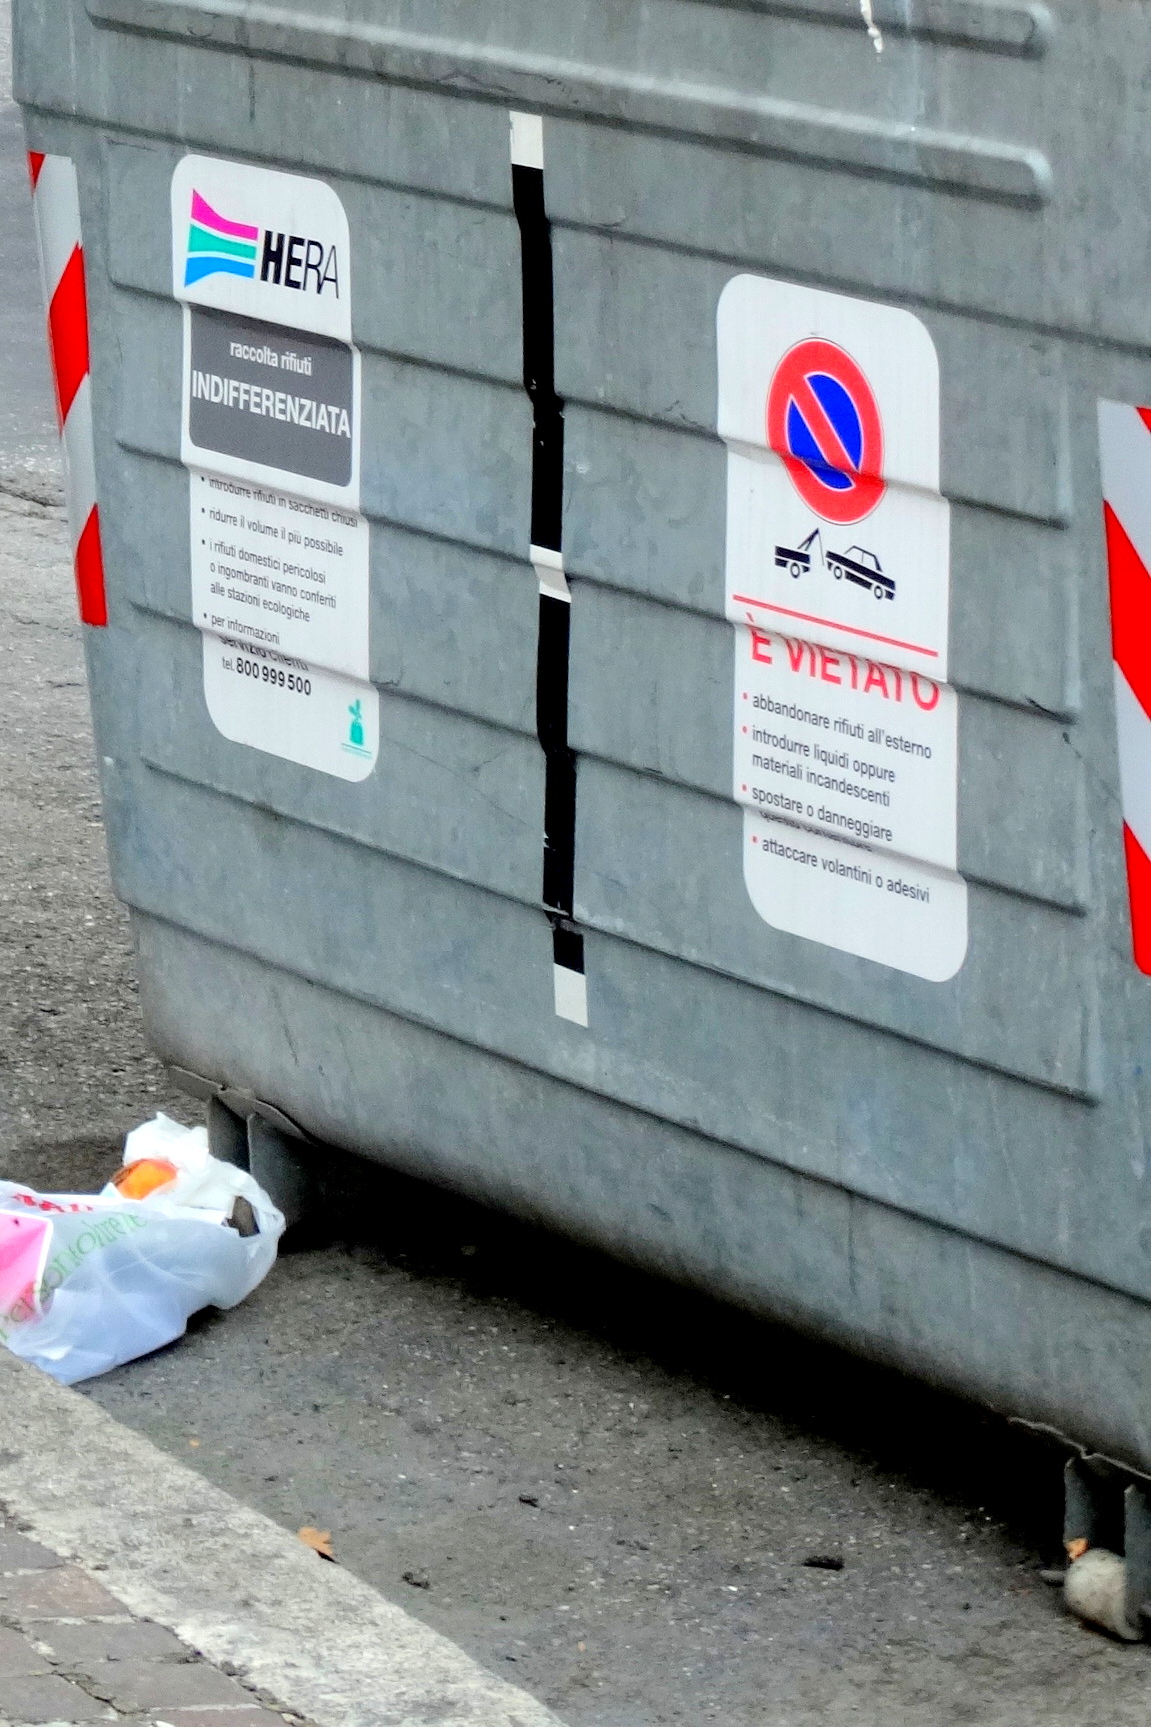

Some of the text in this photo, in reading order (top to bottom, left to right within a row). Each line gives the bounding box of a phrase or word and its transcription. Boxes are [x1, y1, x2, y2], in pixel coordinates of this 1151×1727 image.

[260, 229, 339, 299] HERA
[230, 342, 312, 376] raccolta rifiuti
[192, 370, 351, 439] INDIFFERENZIATA
[209, 478, 358, 528] introdurre rifiuti in sacchetti chiusi
[209, 507, 343, 557] ridurre il volume il più possibile
[210, 562, 337, 609] o ingombranti vanno conferiti
[215, 541, 236, 558] rifiuti
[239, 547, 280, 570] domestici
[283, 562, 326, 585] pericolosi
[210, 582, 311, 623] alle stazioni ecologiche
[211, 614, 280, 645] per informazioni
[222, 656, 312, 696] tel. 800 999 500
[746, 612, 940, 711] È VIETATO
[753, 693, 932, 760] abbandonare rifiuti all'esterno
[752, 725, 895, 783] introdurre liquidi oppure
[752, 753, 890, 807] materiali incandescenti
[752, 786, 803, 814] spostare
[806, 804, 814, 817] o
[817, 805, 893, 842] danneggiare
[762, 838, 930, 904] attaccare volantini o adesivi
